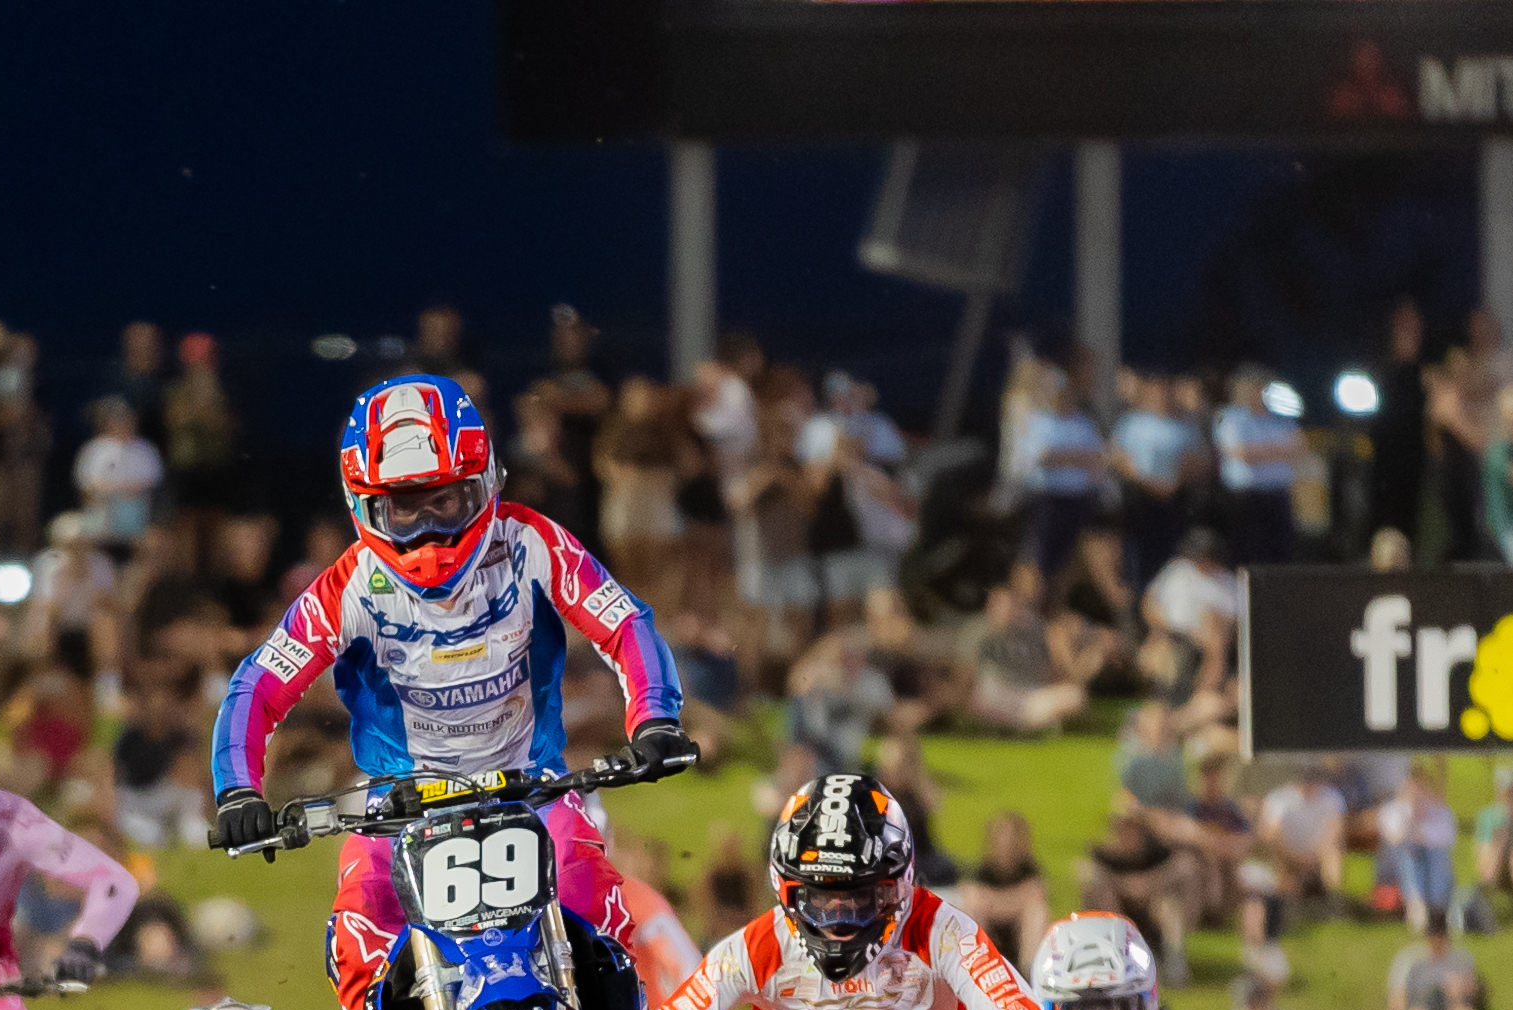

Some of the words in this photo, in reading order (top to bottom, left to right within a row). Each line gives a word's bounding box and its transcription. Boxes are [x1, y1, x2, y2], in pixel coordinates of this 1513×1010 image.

[282, 637, 311, 660] YMF
[269, 652, 295, 678] YMI
[436, 665, 524, 707] YAMAHA
[413, 720, 446, 733] BULK
[447, 709, 514, 735] NUTRIENTS
[816, 774, 862, 848] boost
[423, 827, 539, 922] 69
[799, 864, 854, 874] HONDA
[481, 905, 532, 921] WAGEMAN
